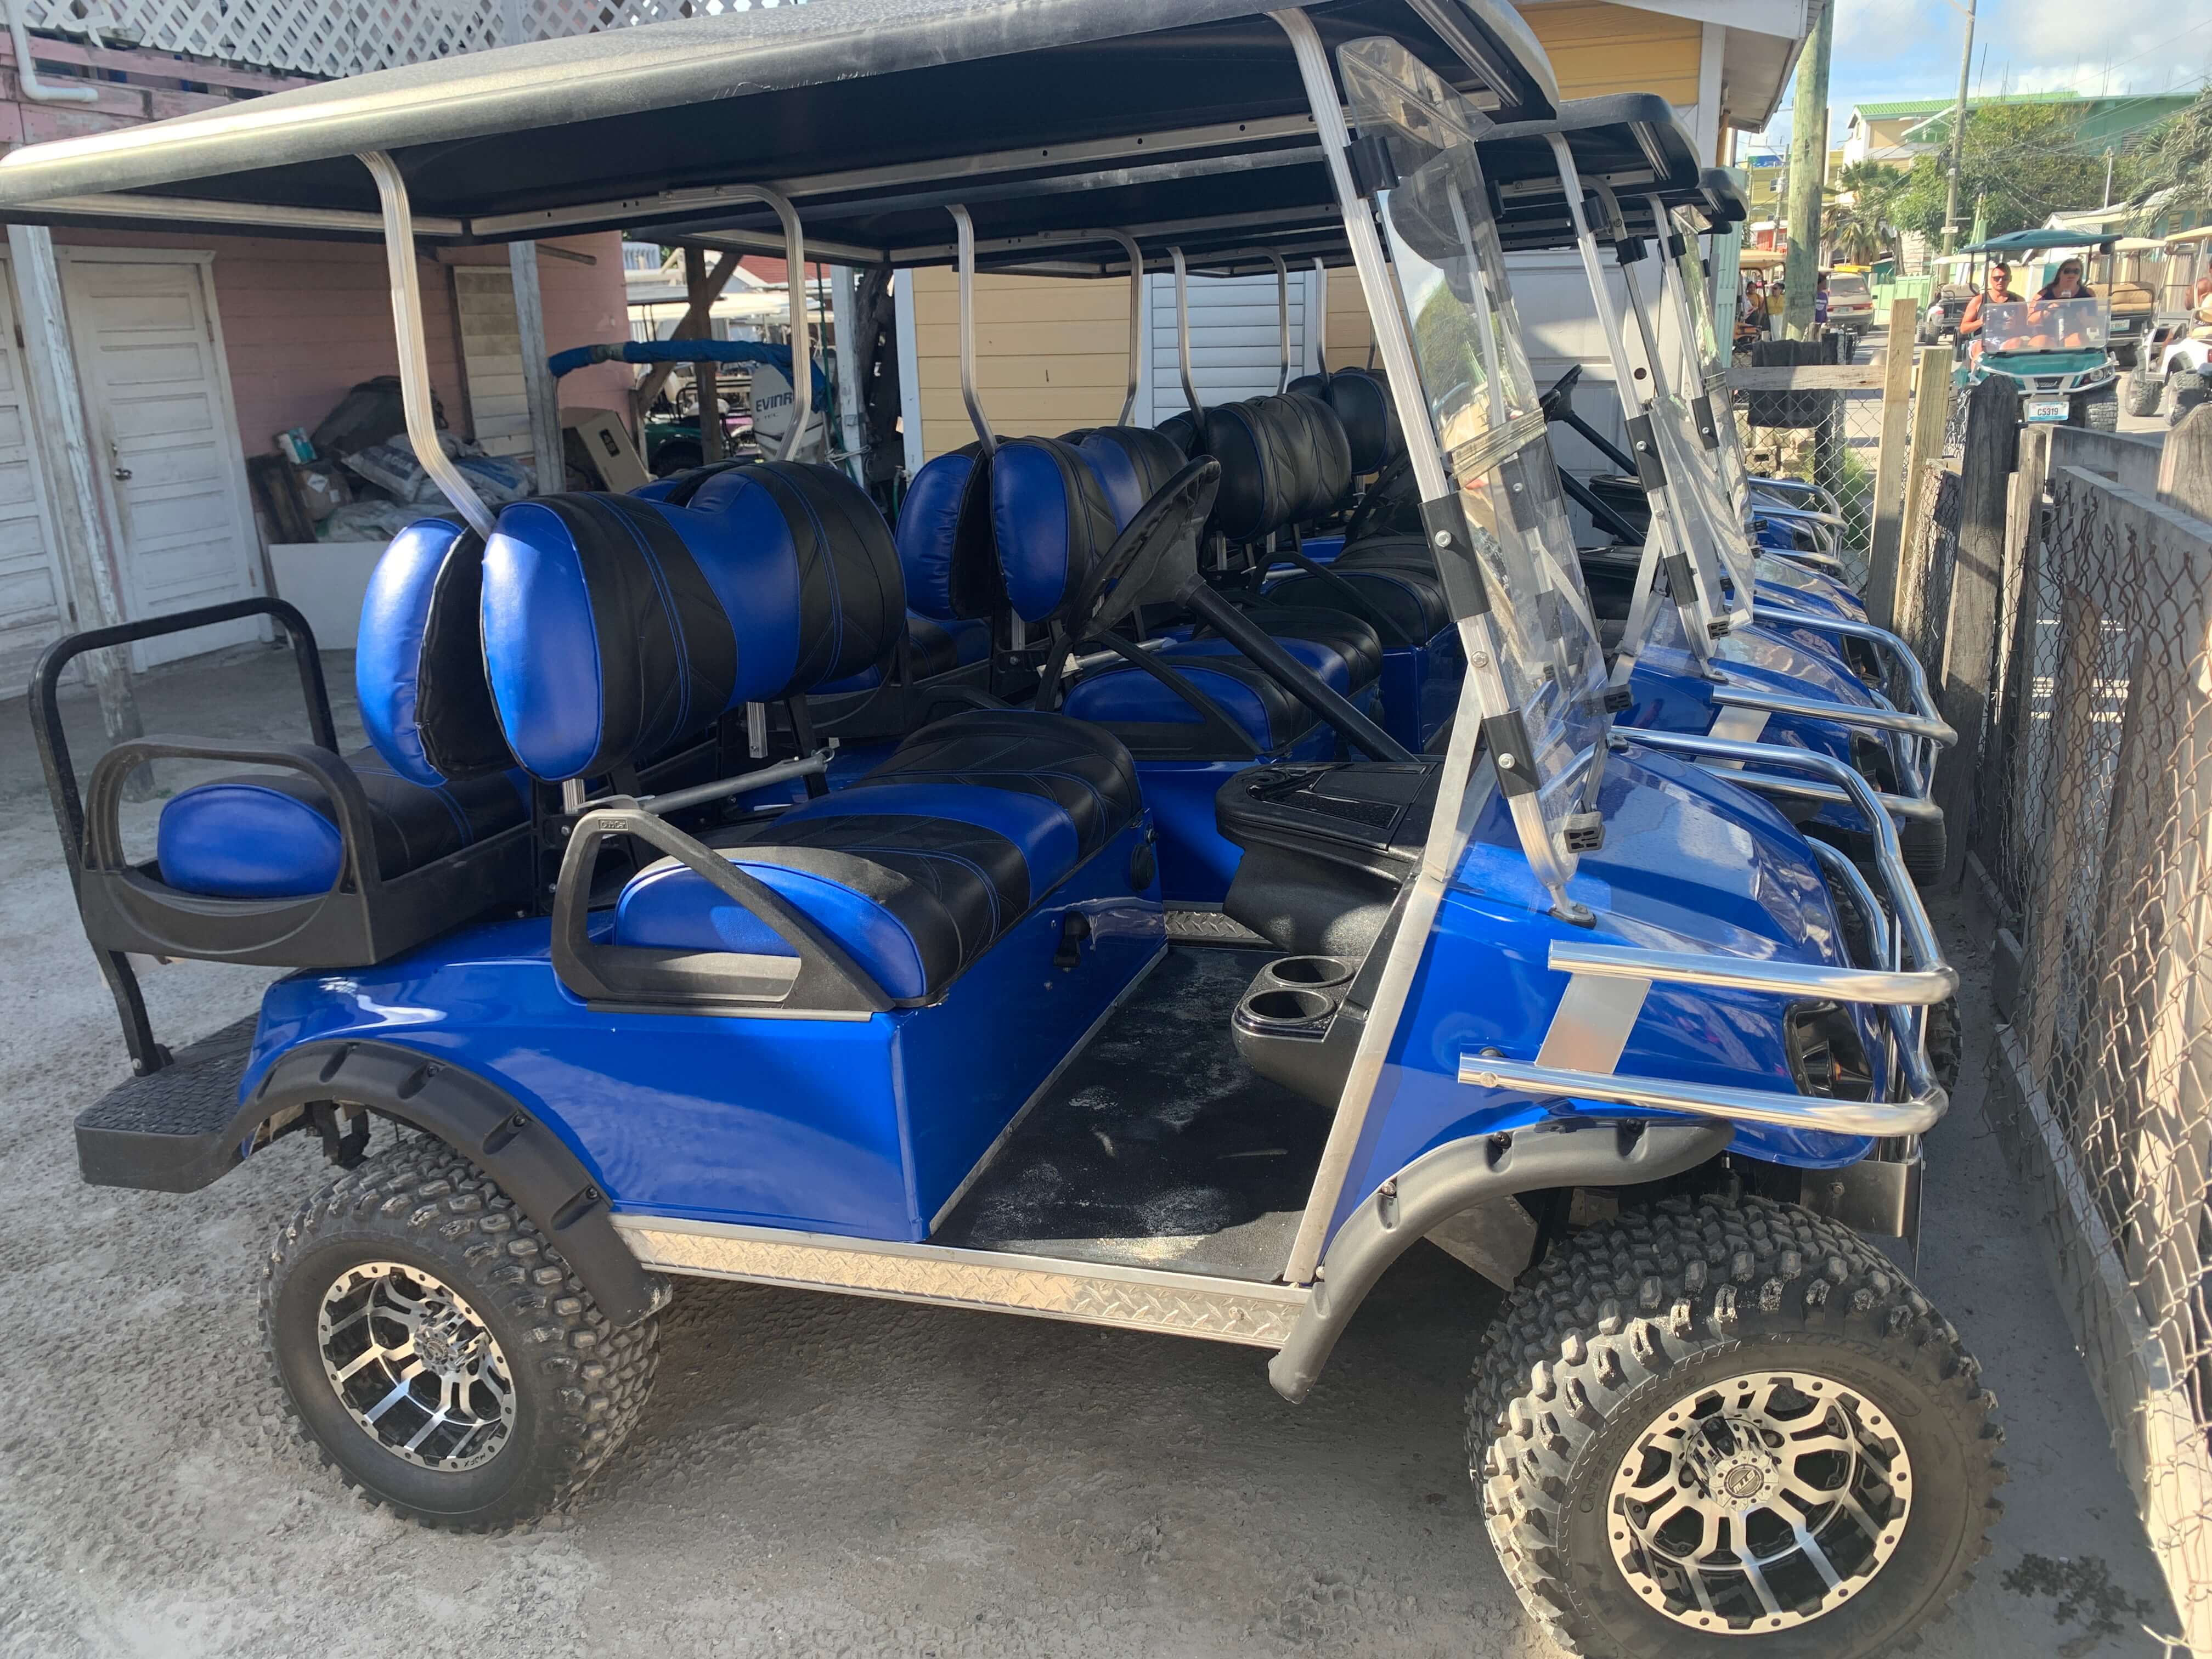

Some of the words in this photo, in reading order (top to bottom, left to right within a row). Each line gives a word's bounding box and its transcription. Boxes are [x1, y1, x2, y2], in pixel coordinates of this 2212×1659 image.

[755, 392, 794, 413] EVINR
[2037, 408, 2059, 416] C5319
[1733, 1470, 1756, 1493] GTW
